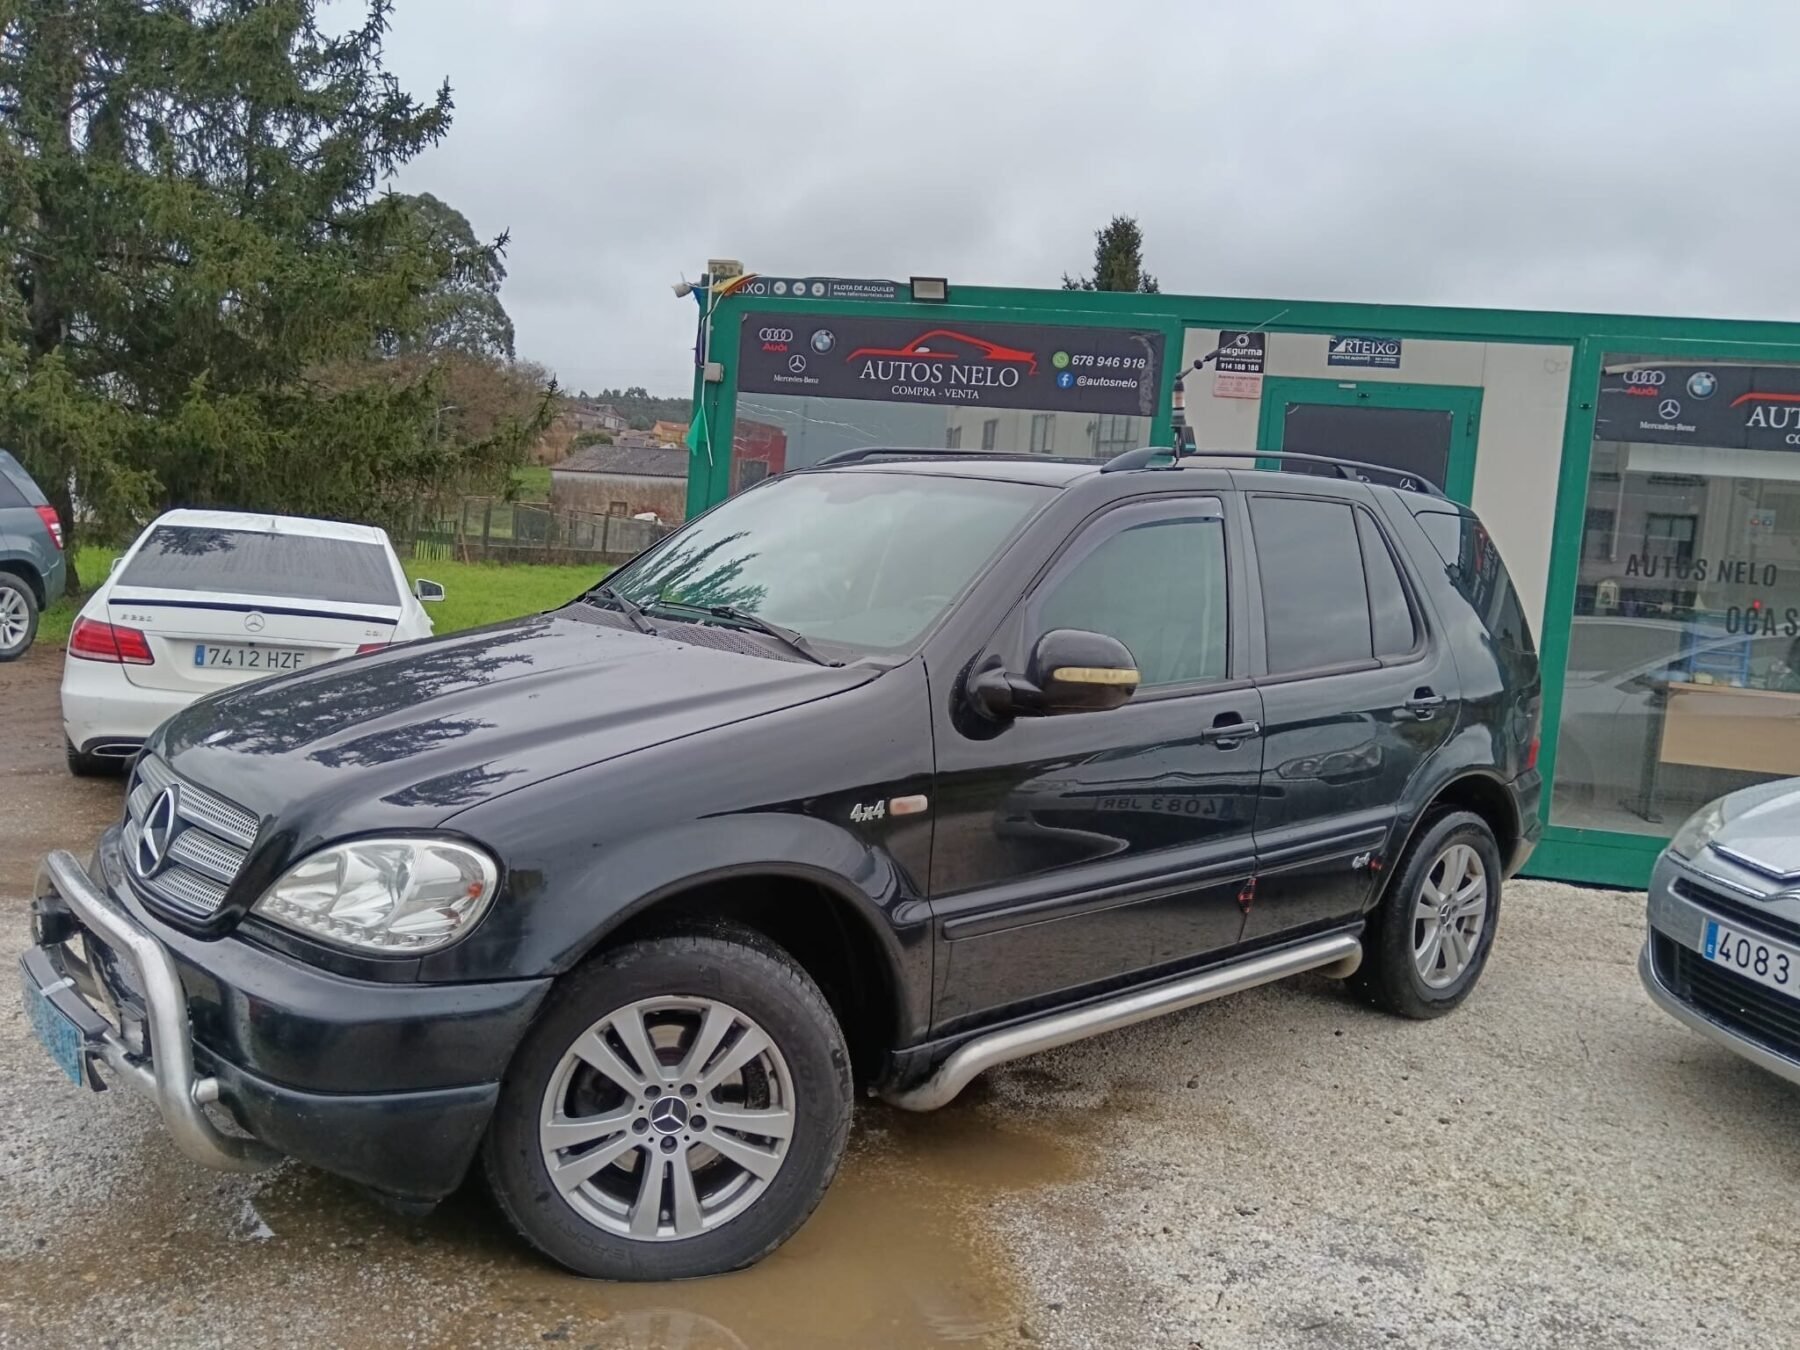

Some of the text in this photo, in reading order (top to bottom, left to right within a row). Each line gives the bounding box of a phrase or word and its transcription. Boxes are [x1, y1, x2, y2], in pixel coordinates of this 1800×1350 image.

[735, 283, 765, 295] IXO
[864, 285, 895, 293] ALQUILER
[762, 343, 788, 352] Audi
[1072, 355, 1145, 369] 678 946 918
[773, 374, 819, 384] Mercedes-Benz
[859, 360, 1019, 387] AUTOS NELO
[1077, 375, 1138, 388] @autosnelo
[892, 385, 936, 397] COMPRA
[945, 388, 979, 399] VENTA
[1626, 386, 1658, 396] Audi
[1640, 421, 1696, 432] Mercedes-Benz
[1625, 554, 1777, 587] AUTOS NELO
[208, 648, 305, 669] 7412 HZF
[850, 800, 886, 822] 4x4
[1719, 932, 1790, 985] 4083
